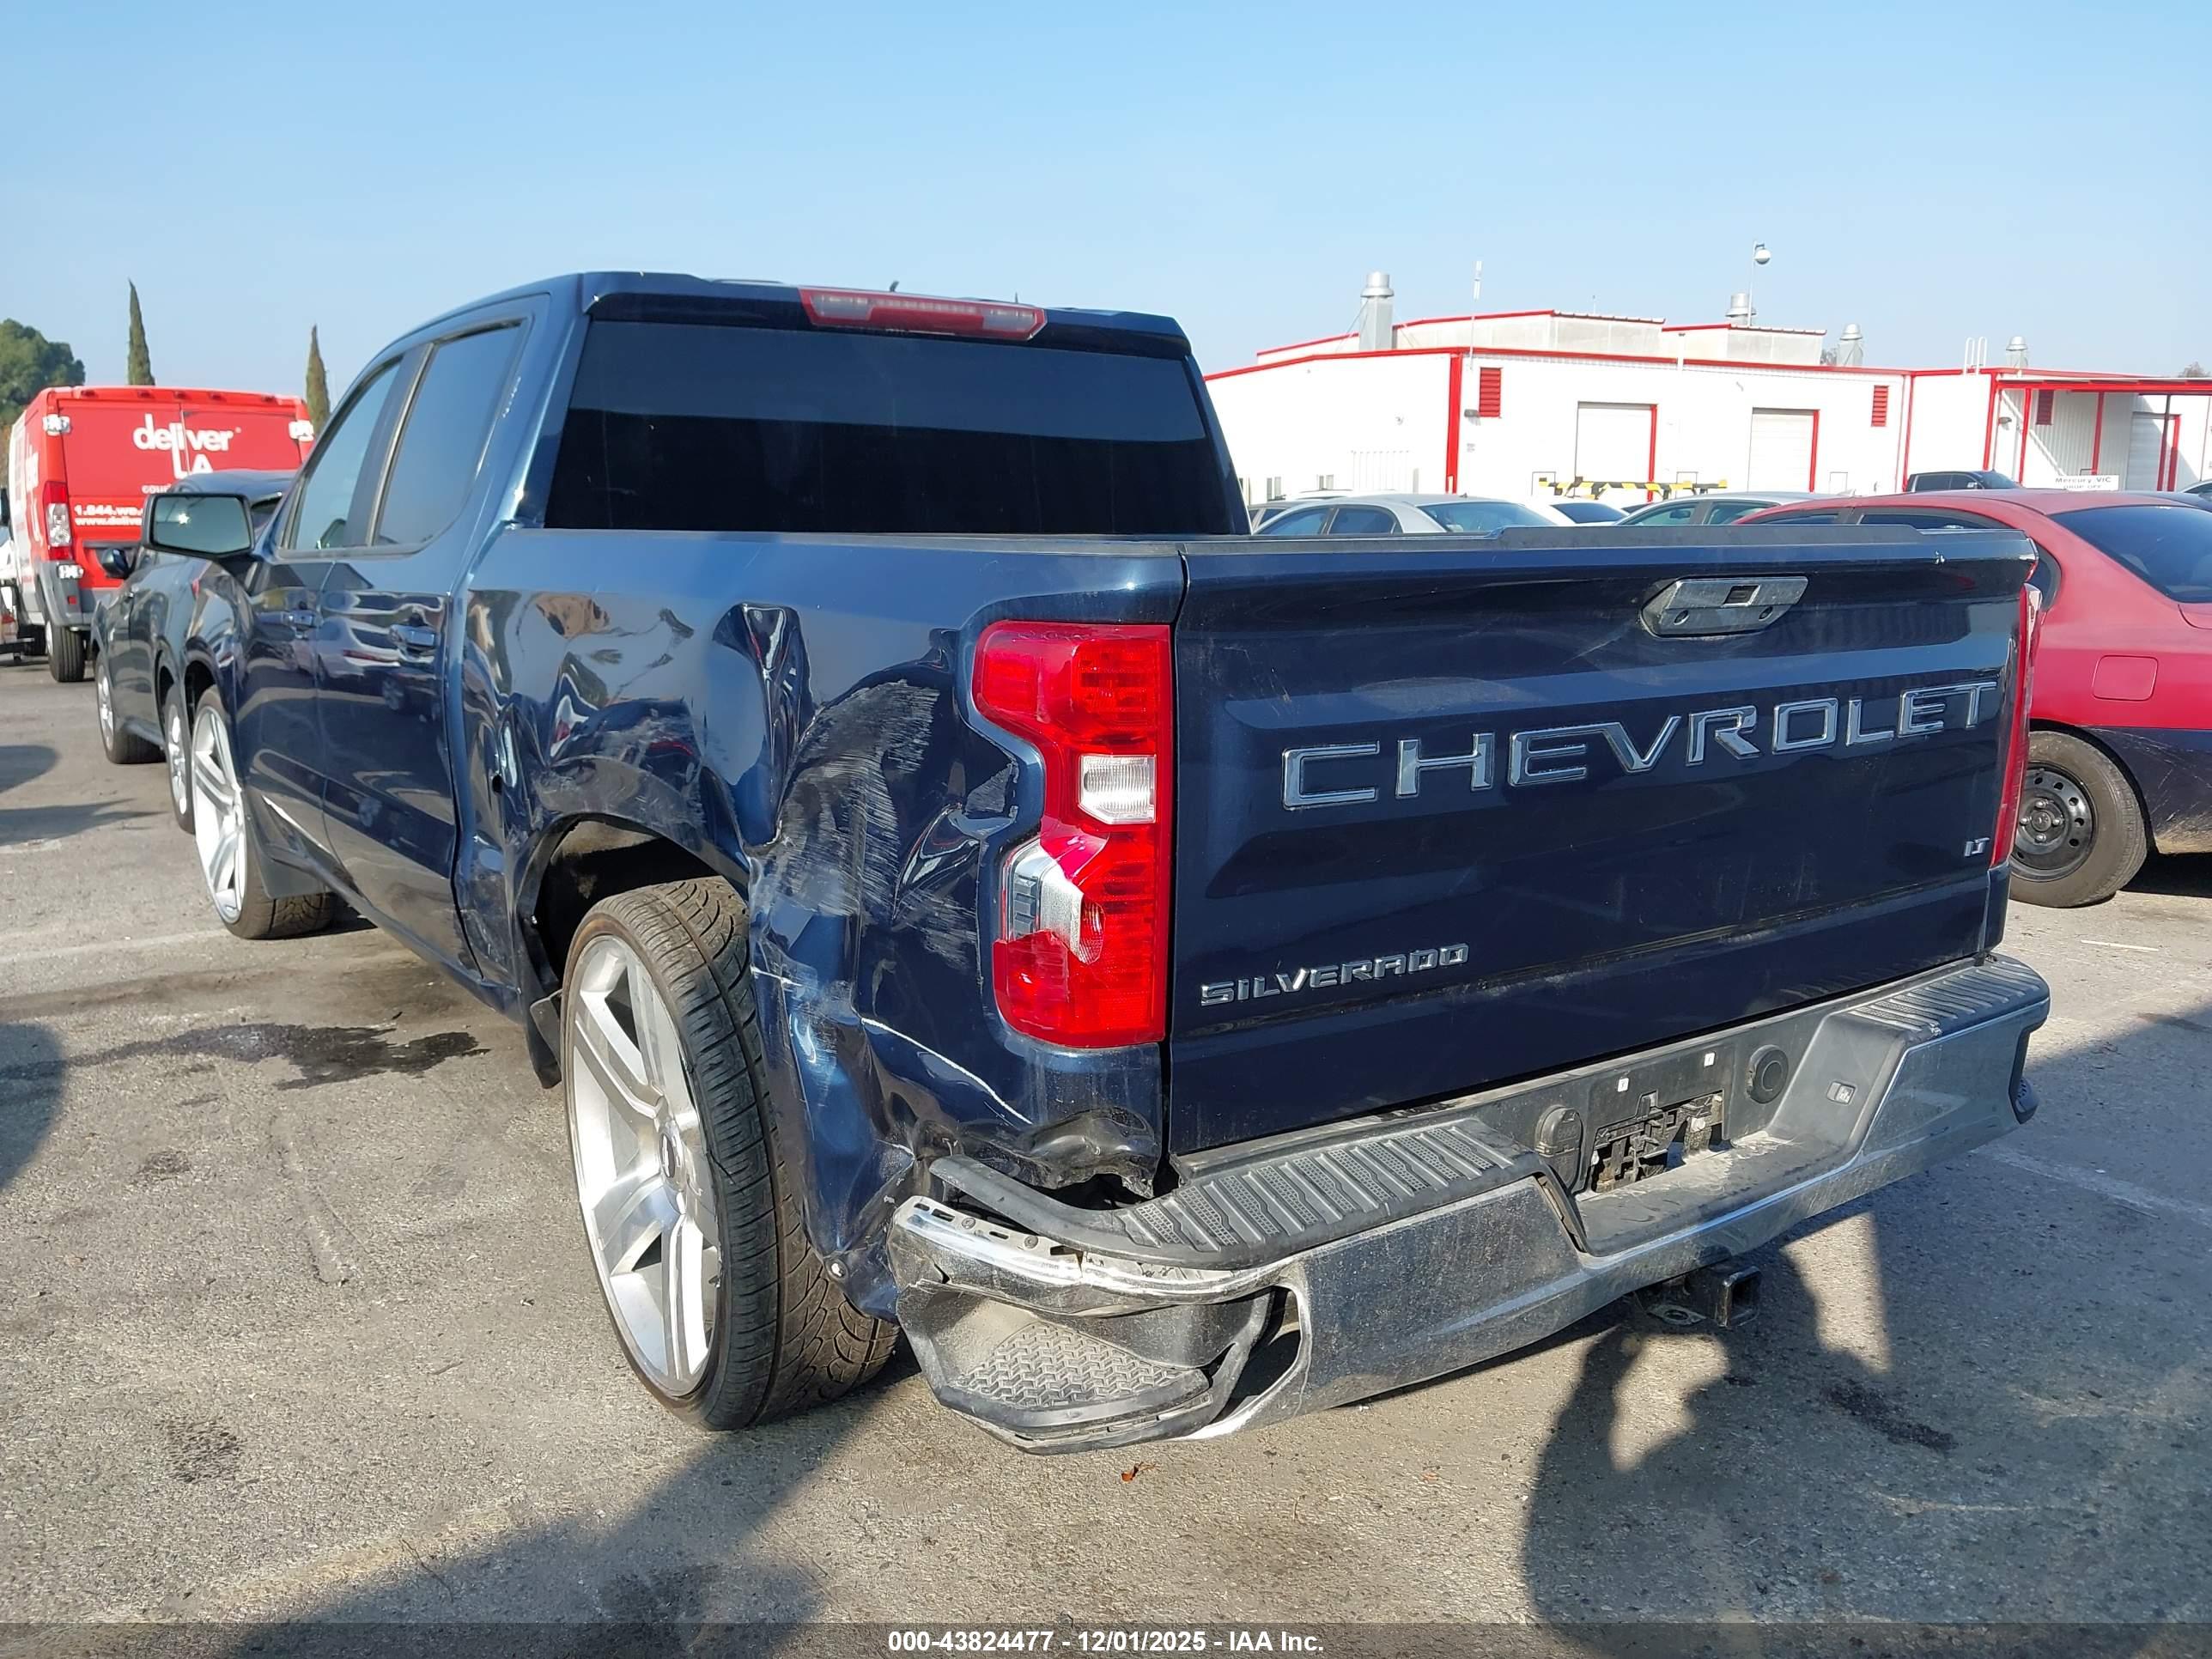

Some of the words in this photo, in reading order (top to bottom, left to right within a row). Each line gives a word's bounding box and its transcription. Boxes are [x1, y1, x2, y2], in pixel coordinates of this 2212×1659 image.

[133, 413, 234, 451] deliver
[1282, 680, 1998, 811] CHEVROLET
[1200, 942, 1469, 1006] SILVERADO
